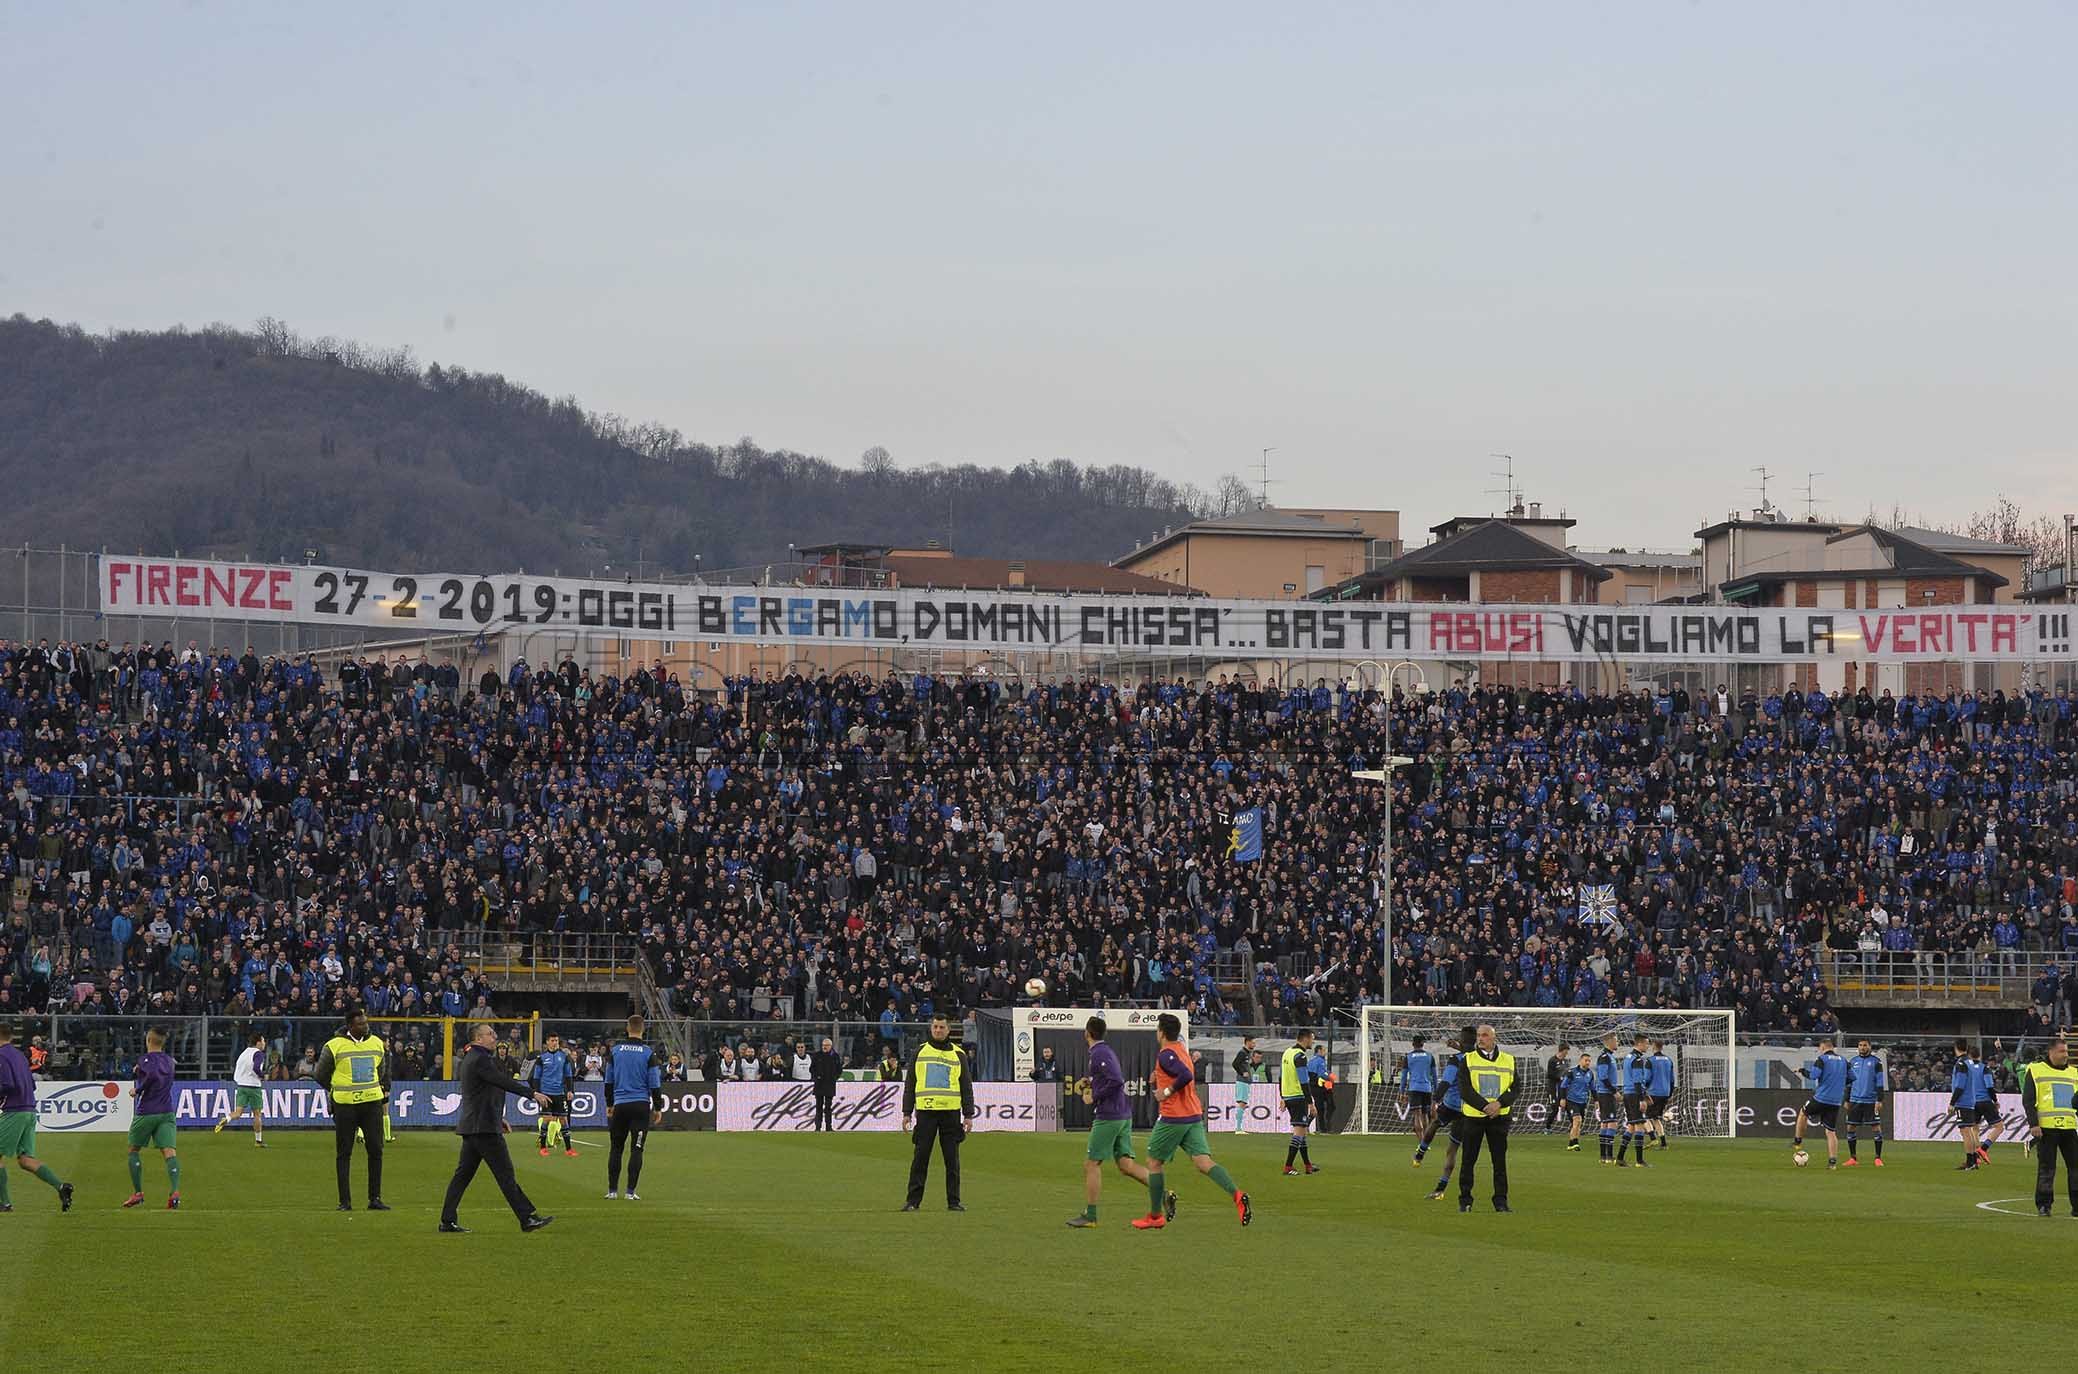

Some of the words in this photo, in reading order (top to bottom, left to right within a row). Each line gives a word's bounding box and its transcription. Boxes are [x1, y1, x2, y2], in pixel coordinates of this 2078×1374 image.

[109, 563, 293, 611] FIRENZE
[1266, 609, 1411, 650] BASTA
[1429, 613, 1543, 652] ABUSI
[1564, 615, 1760, 655] VOGLIAMO
[1780, 616, 1834, 655] LA
[649, 1093, 714, 1113] 0:00
